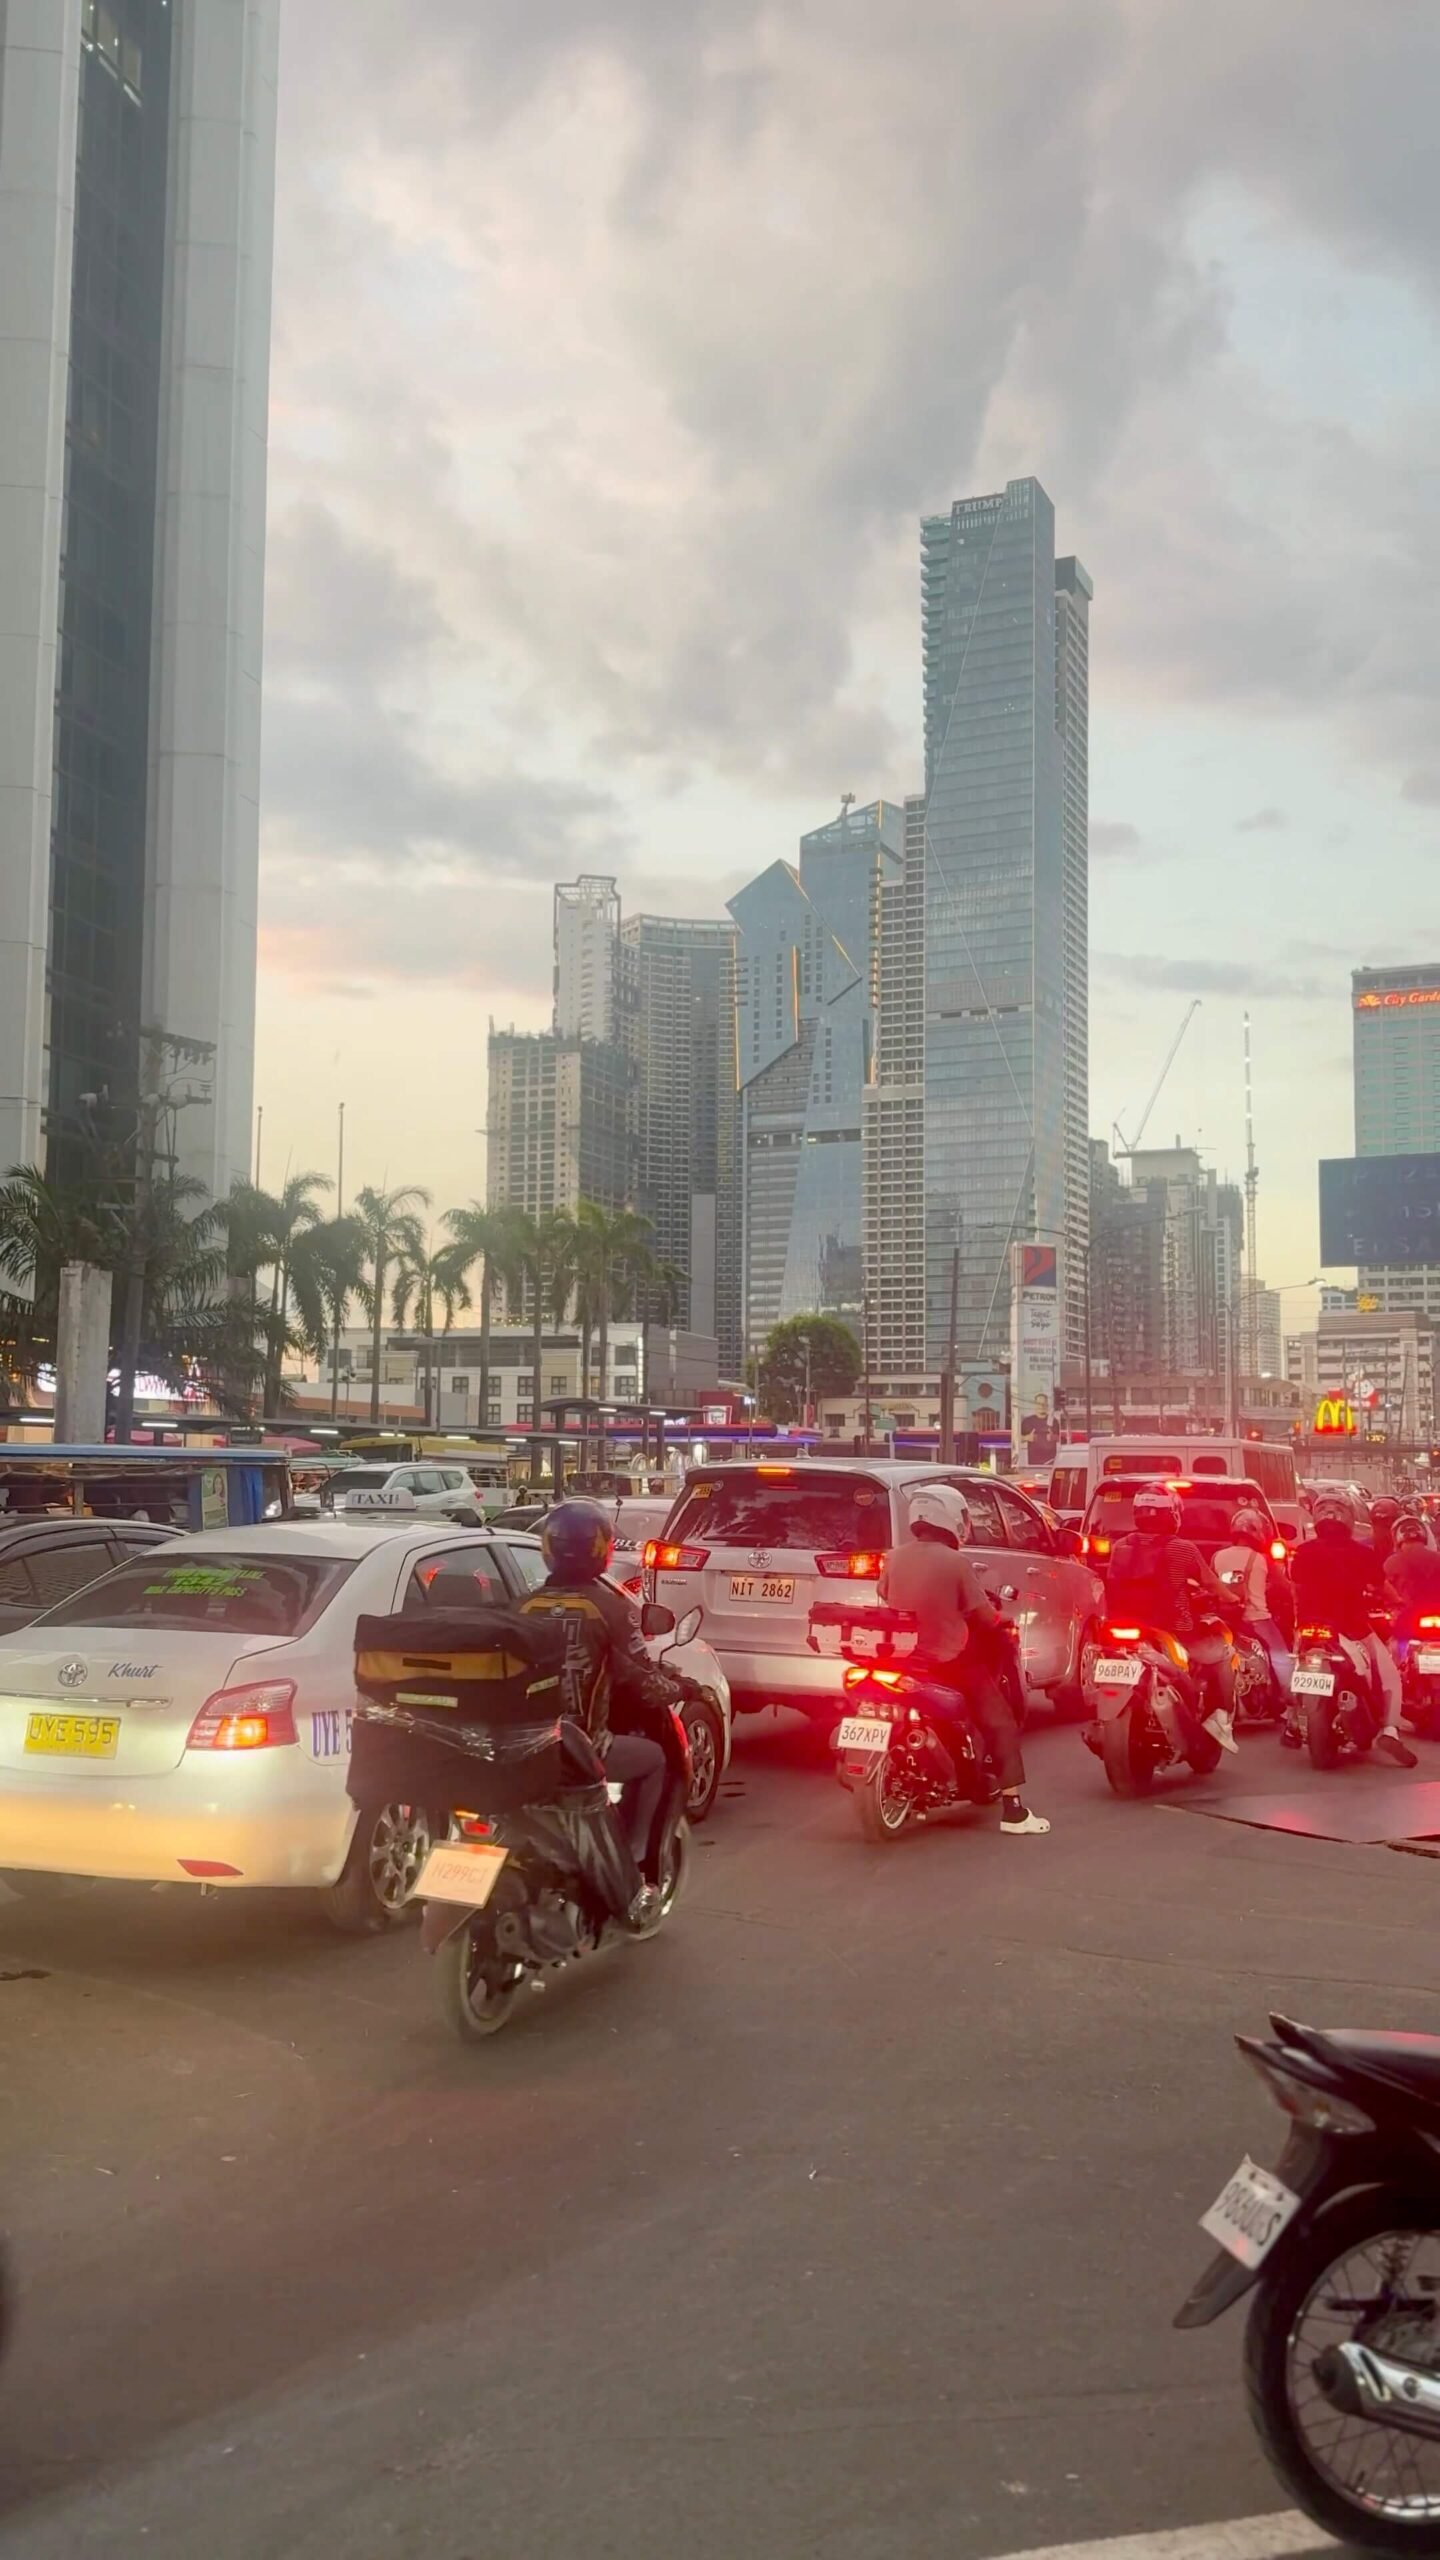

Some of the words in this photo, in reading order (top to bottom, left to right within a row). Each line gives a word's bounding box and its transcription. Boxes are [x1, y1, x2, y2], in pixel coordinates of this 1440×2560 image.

[954, 498, 1003, 515] TRUMP
[1384, 992, 1406, 1007] City
[1022, 1291, 1057, 1301] PETRON
[353, 1494, 395, 1505] TAXI
[731, 1582, 754, 1596] NIT
[761, 1583, 792, 1598] 2862
[108, 1662, 163, 1679] Khurt
[841, 1725, 888, 1744] 367XPY
